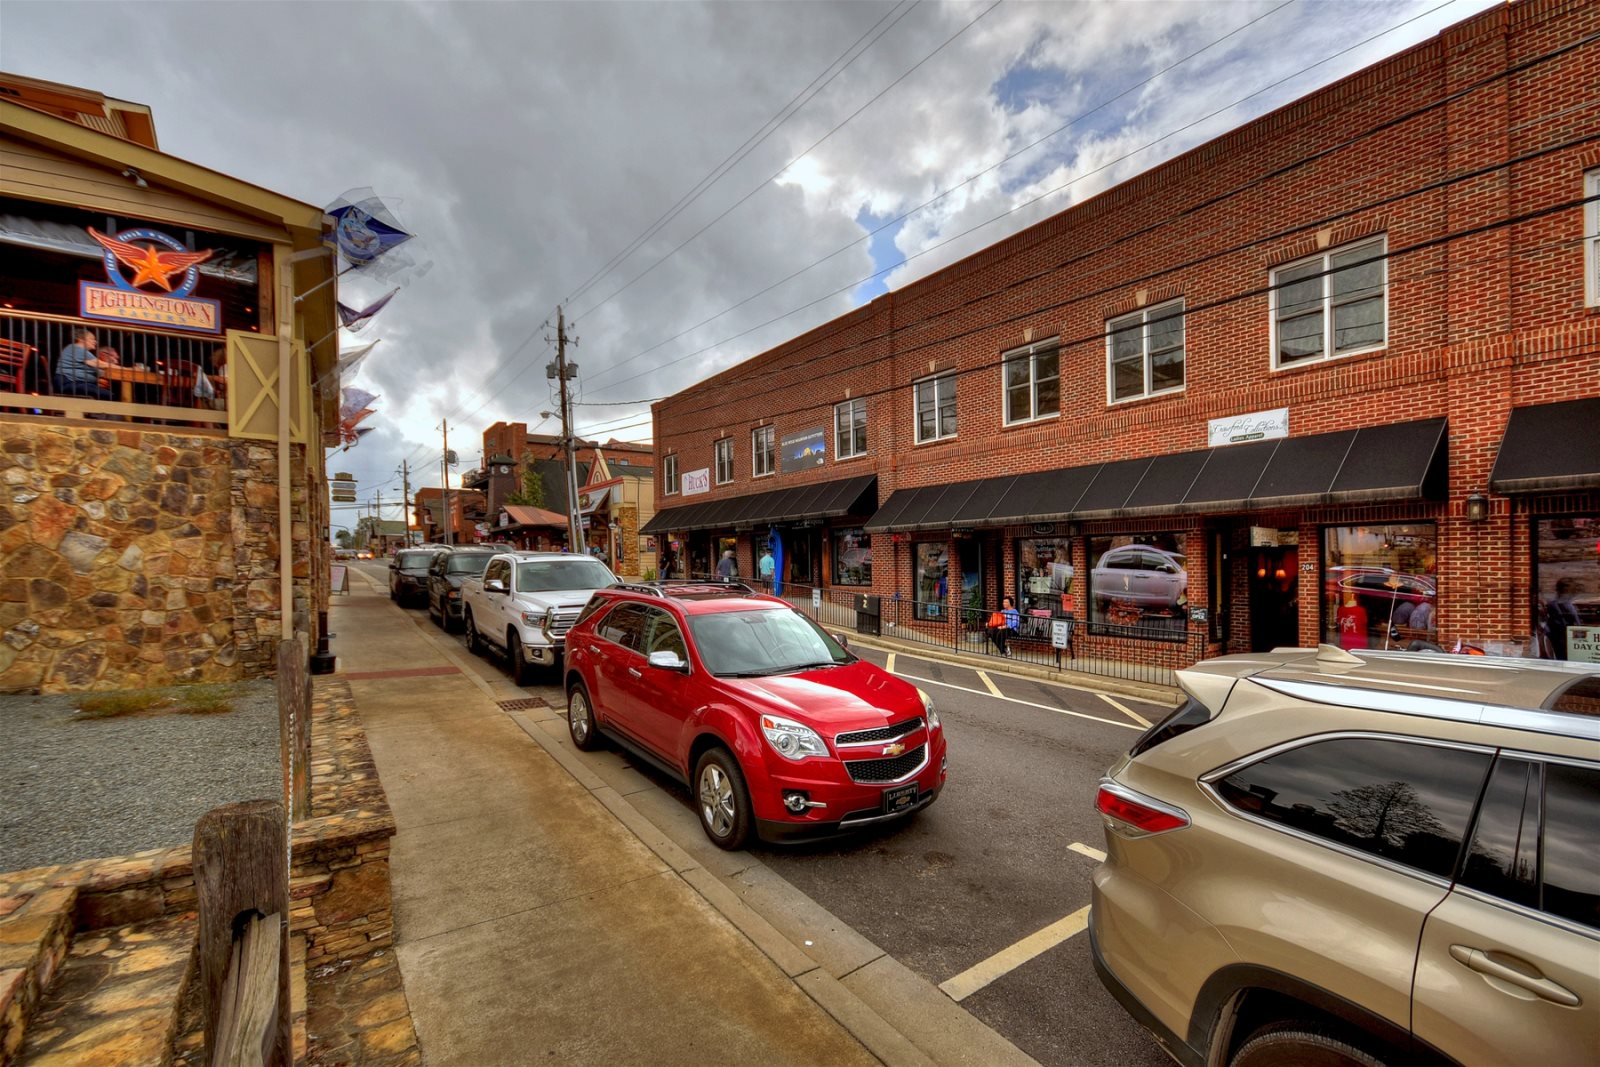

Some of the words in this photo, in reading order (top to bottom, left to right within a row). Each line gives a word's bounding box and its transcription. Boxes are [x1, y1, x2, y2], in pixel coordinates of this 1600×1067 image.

[89, 288, 212, 322] FIGHTINGTOWN
[118, 307, 188, 323] TAVERN
[1301, 562, 1314, 571] 204
